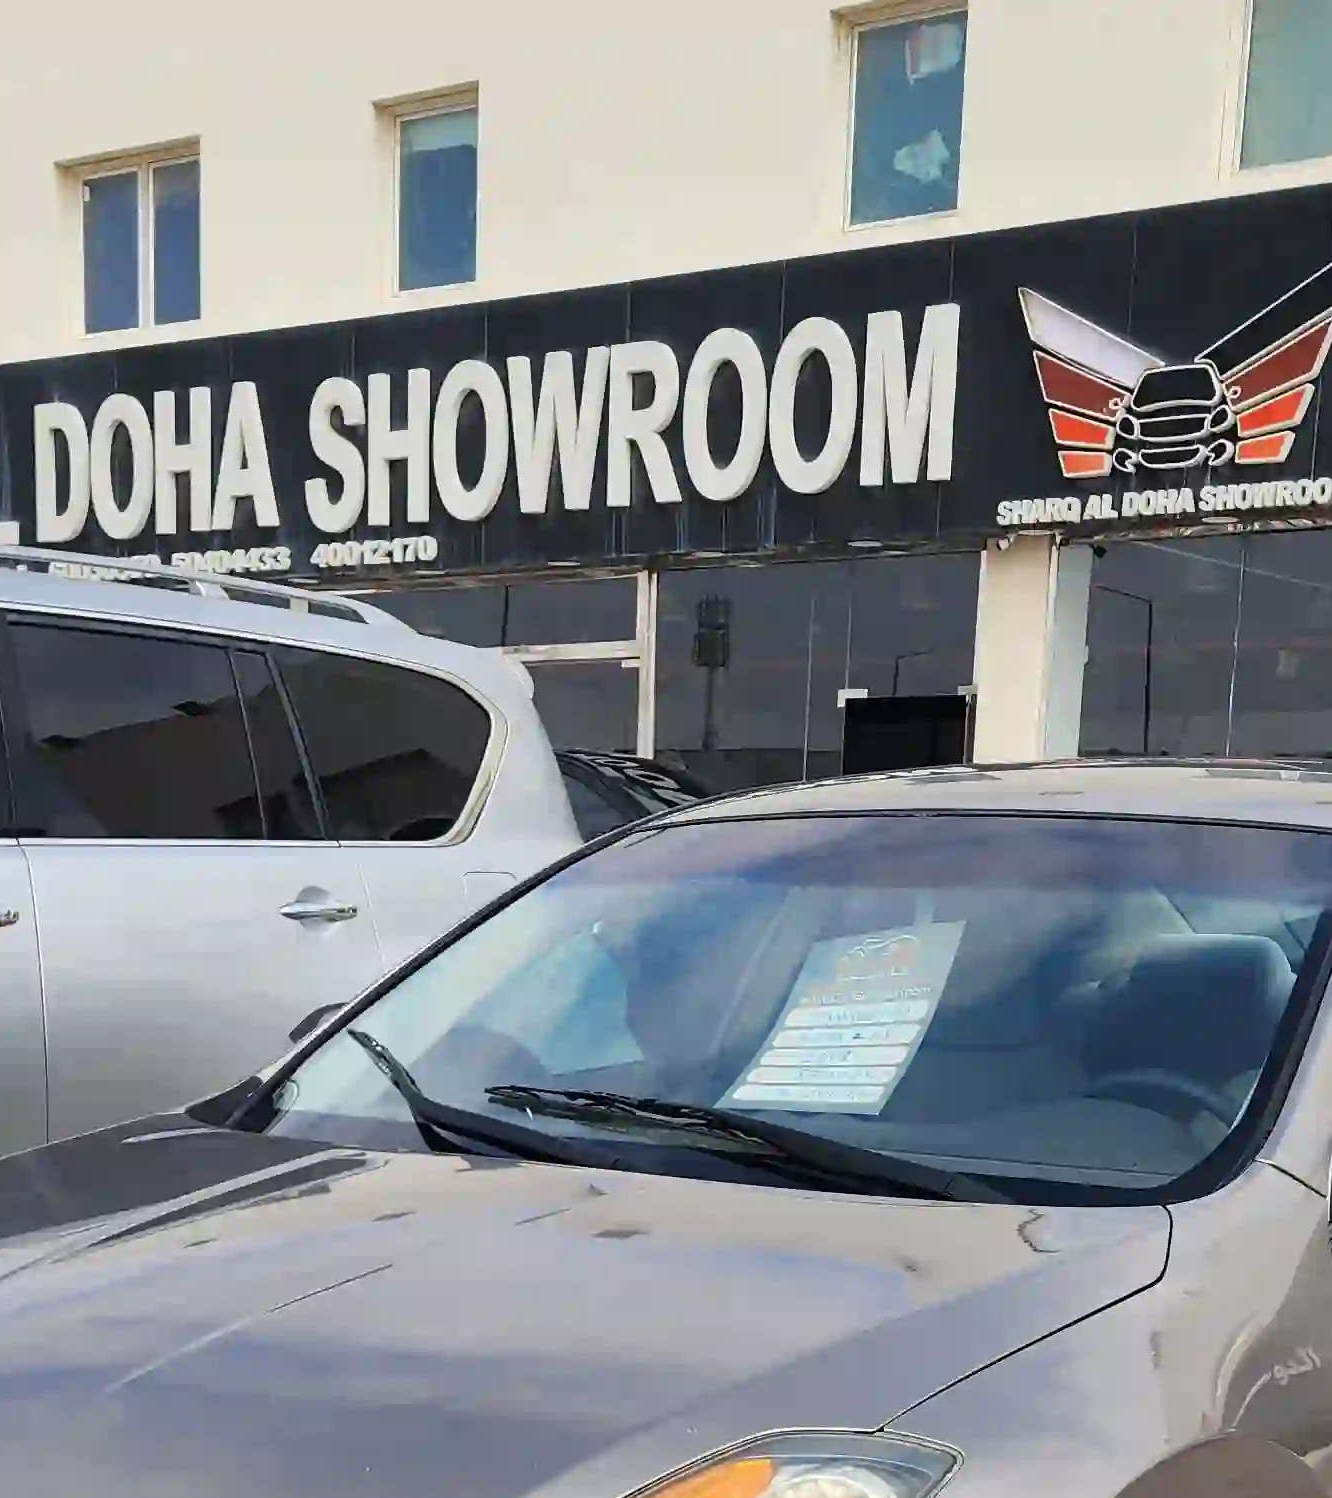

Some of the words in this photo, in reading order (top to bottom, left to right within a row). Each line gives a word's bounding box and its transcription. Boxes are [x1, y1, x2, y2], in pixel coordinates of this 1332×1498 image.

[33, 379, 281, 544] DOHA
[304, 302, 961, 534] SHOWROOM
[996, 497, 1081, 528] SHARQ
[1084, 493, 1119, 522] AL
[1121, 487, 1196, 518] DOHA
